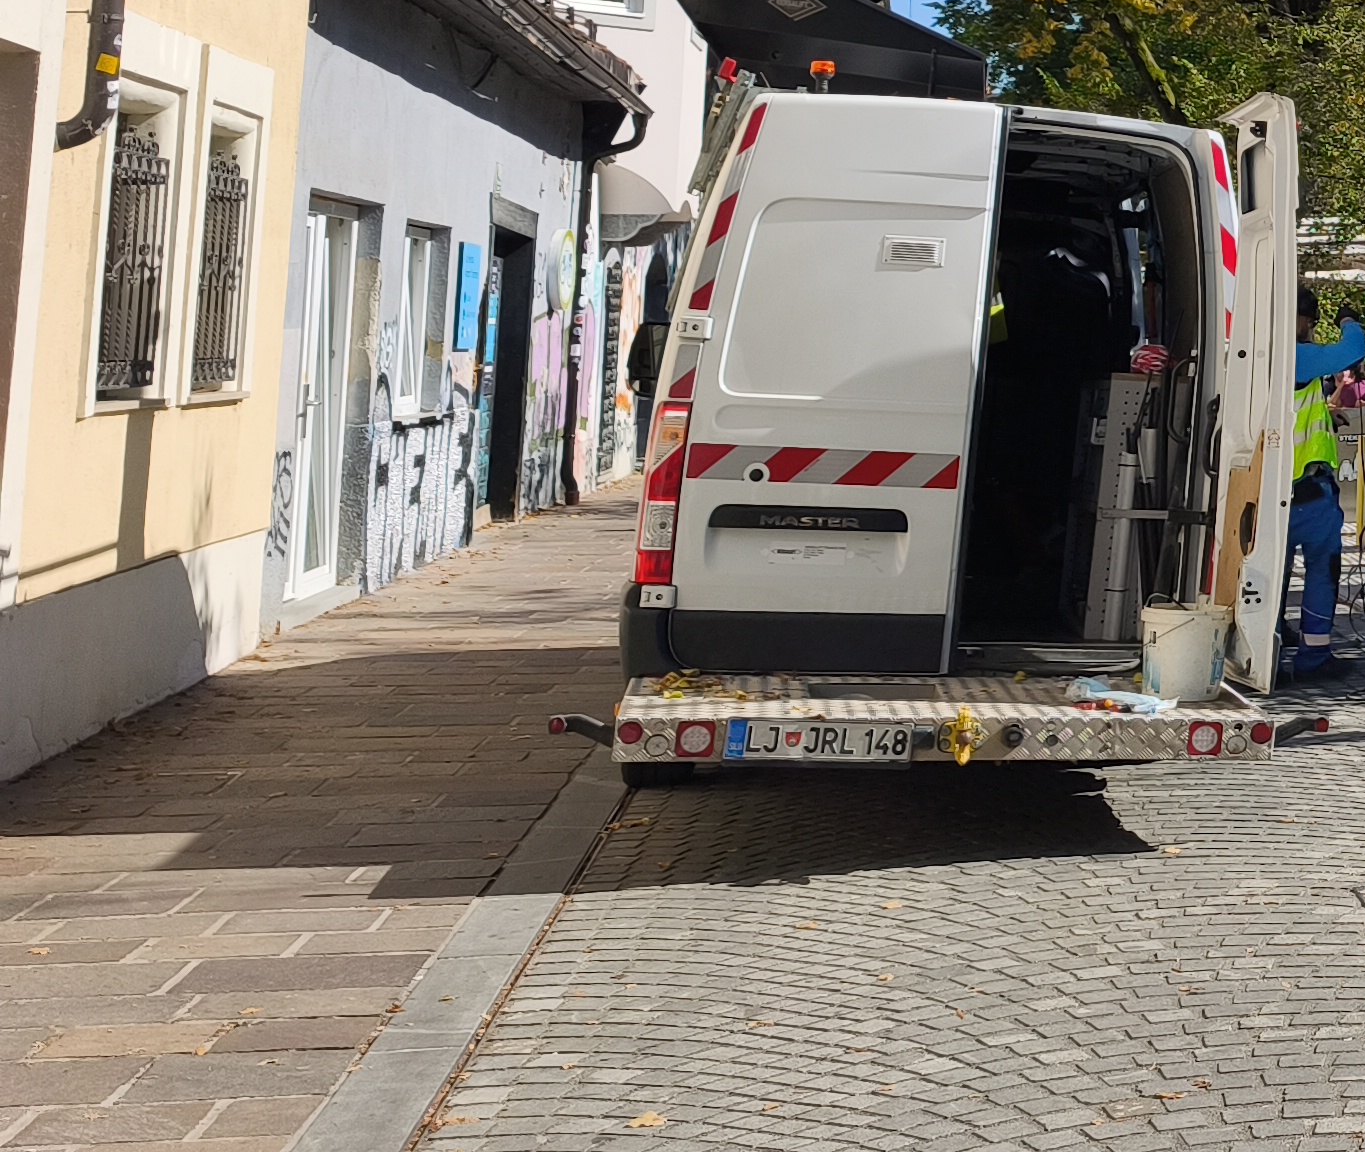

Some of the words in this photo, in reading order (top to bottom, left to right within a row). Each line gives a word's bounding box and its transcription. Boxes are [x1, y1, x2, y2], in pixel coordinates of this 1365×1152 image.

[759, 514, 861, 529] MASTER
[745, 725, 780, 753] LJ
[803, 727, 854, 755] JRL
[864, 728, 908, 756] 148
